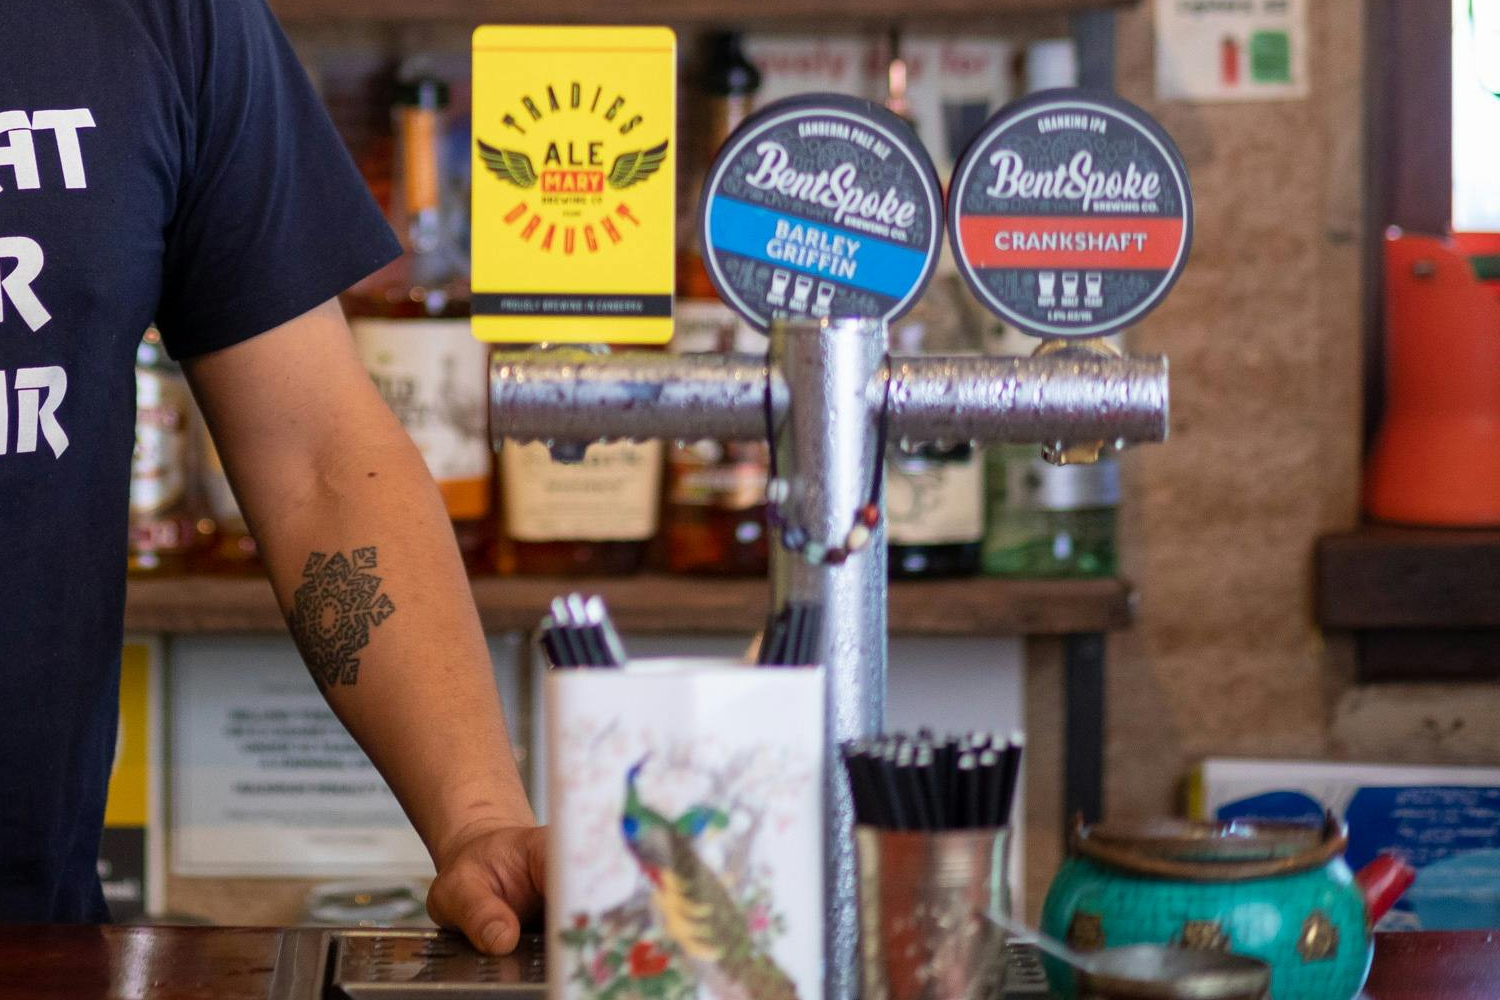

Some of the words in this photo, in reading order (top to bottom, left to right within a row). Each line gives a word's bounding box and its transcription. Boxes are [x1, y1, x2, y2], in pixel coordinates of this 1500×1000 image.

[500, 82, 644, 136] TRADIES
[798, 121, 849, 139] CANBERRA
[850, 128, 874, 150] PALE
[1038, 115, 1088, 134] CRANKING
[1090, 118, 1107, 134] IPA
[544, 141, 604, 166] ALE
[544, 172, 603, 192] MARY
[746, 140, 916, 229] BentSpoke
[986, 150, 1160, 212] BentSpoke
[541, 195, 587, 205] BREWING
[1092, 201, 1140, 213] BREWING
[503, 201, 640, 256] DRAUGHT
[775, 219, 861, 258] BARLEY
[844, 215, 889, 238] BREWING
[994, 231, 1148, 253] CRANKSHAFT
[766, 239, 858, 280] GRIFFIN
[500, 299, 540, 311] PROUDLY
[542, 300, 583, 312] BREWING
[587, 301, 596, 312] IN
[596, 301, 644, 313] CANBERRA
